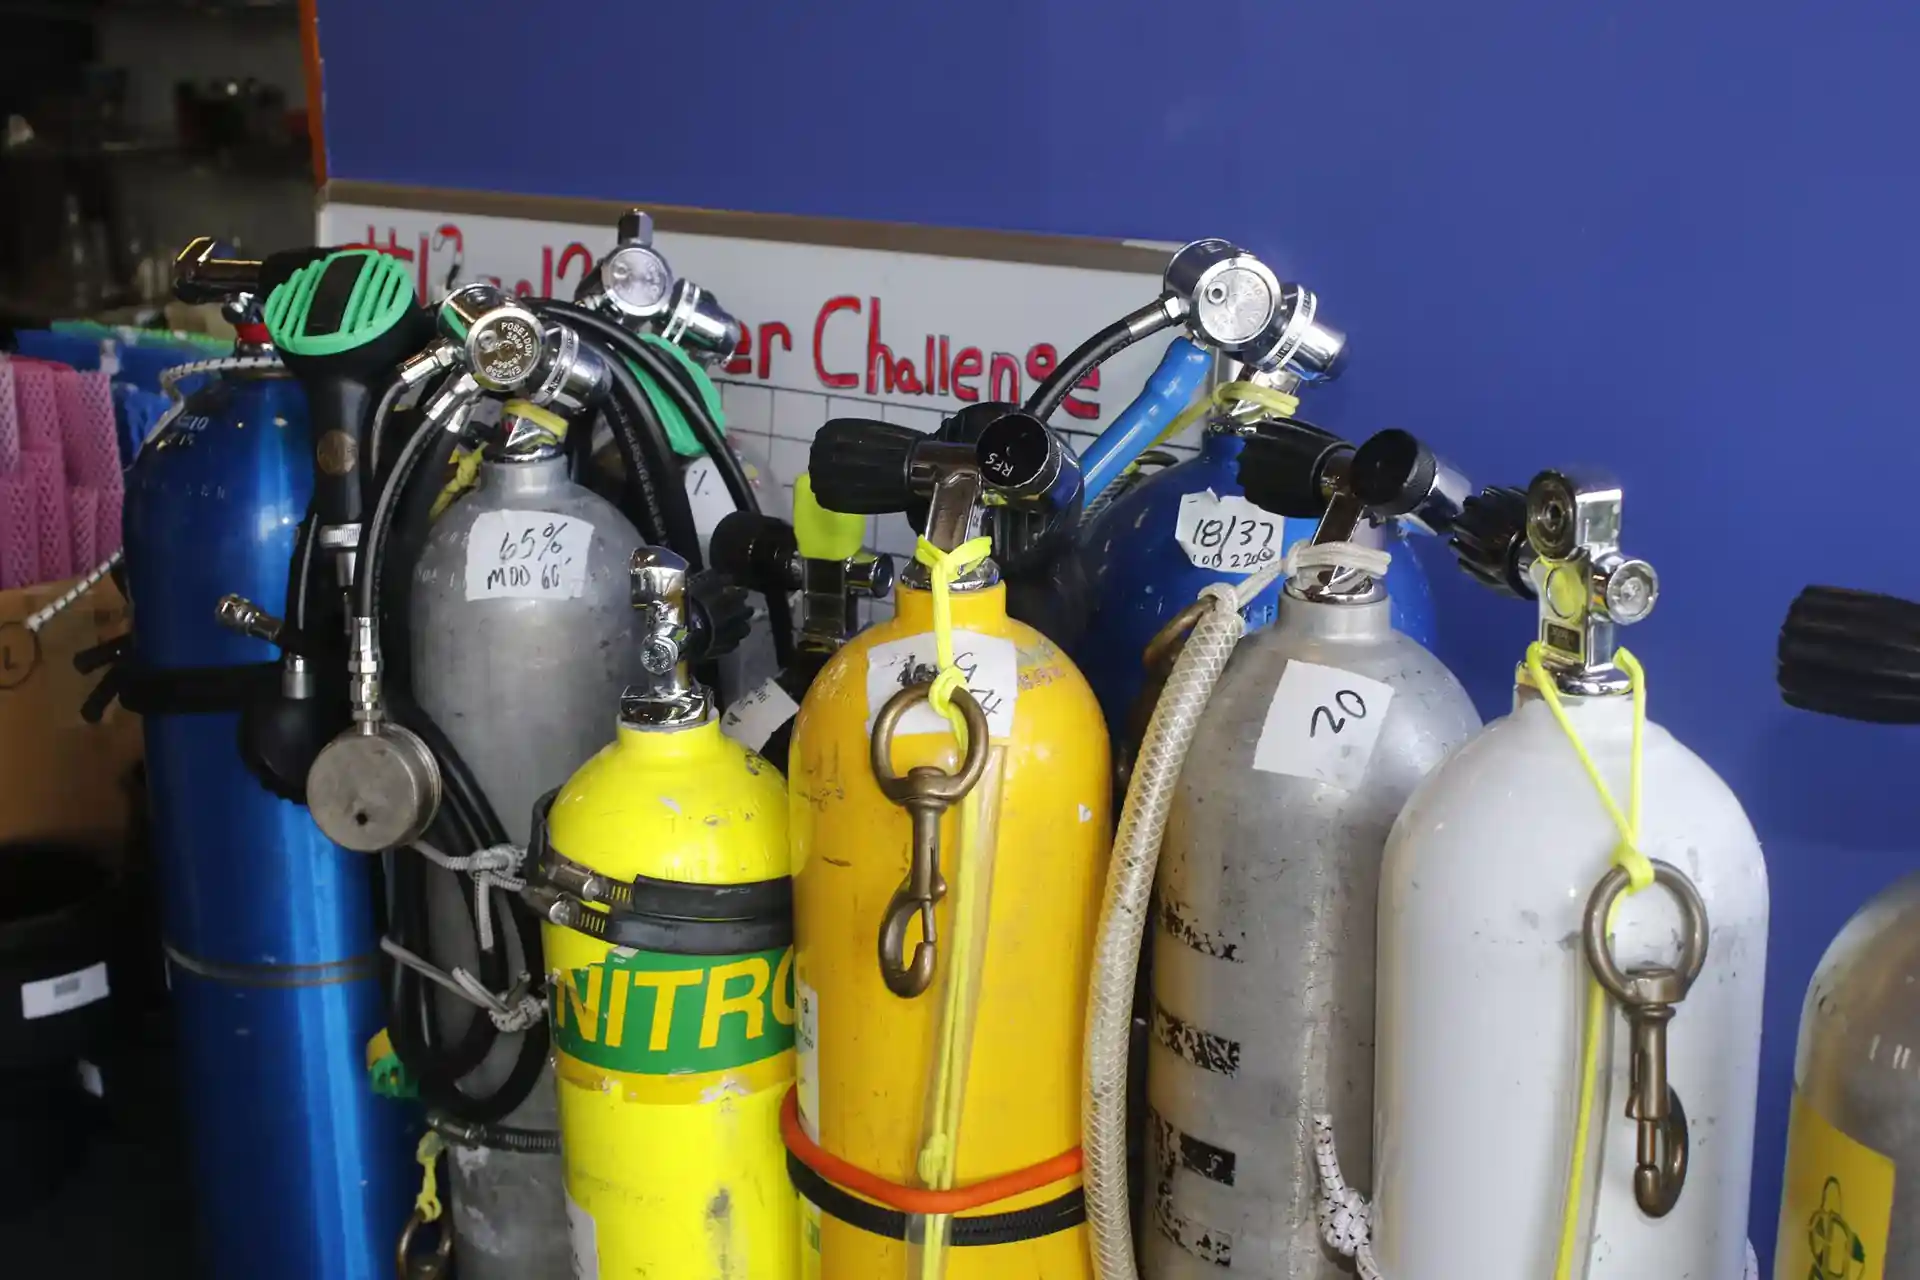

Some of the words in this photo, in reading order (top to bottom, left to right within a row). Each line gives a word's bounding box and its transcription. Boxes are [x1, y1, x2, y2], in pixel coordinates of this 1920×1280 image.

[501, 322, 533, 357] POSEIDON
[812, 295, 1101, 420] Challenge
[499, 521, 568, 561] 65%
[1191, 515, 1274, 560] 18/37
[1309, 689, 1367, 739] 20
